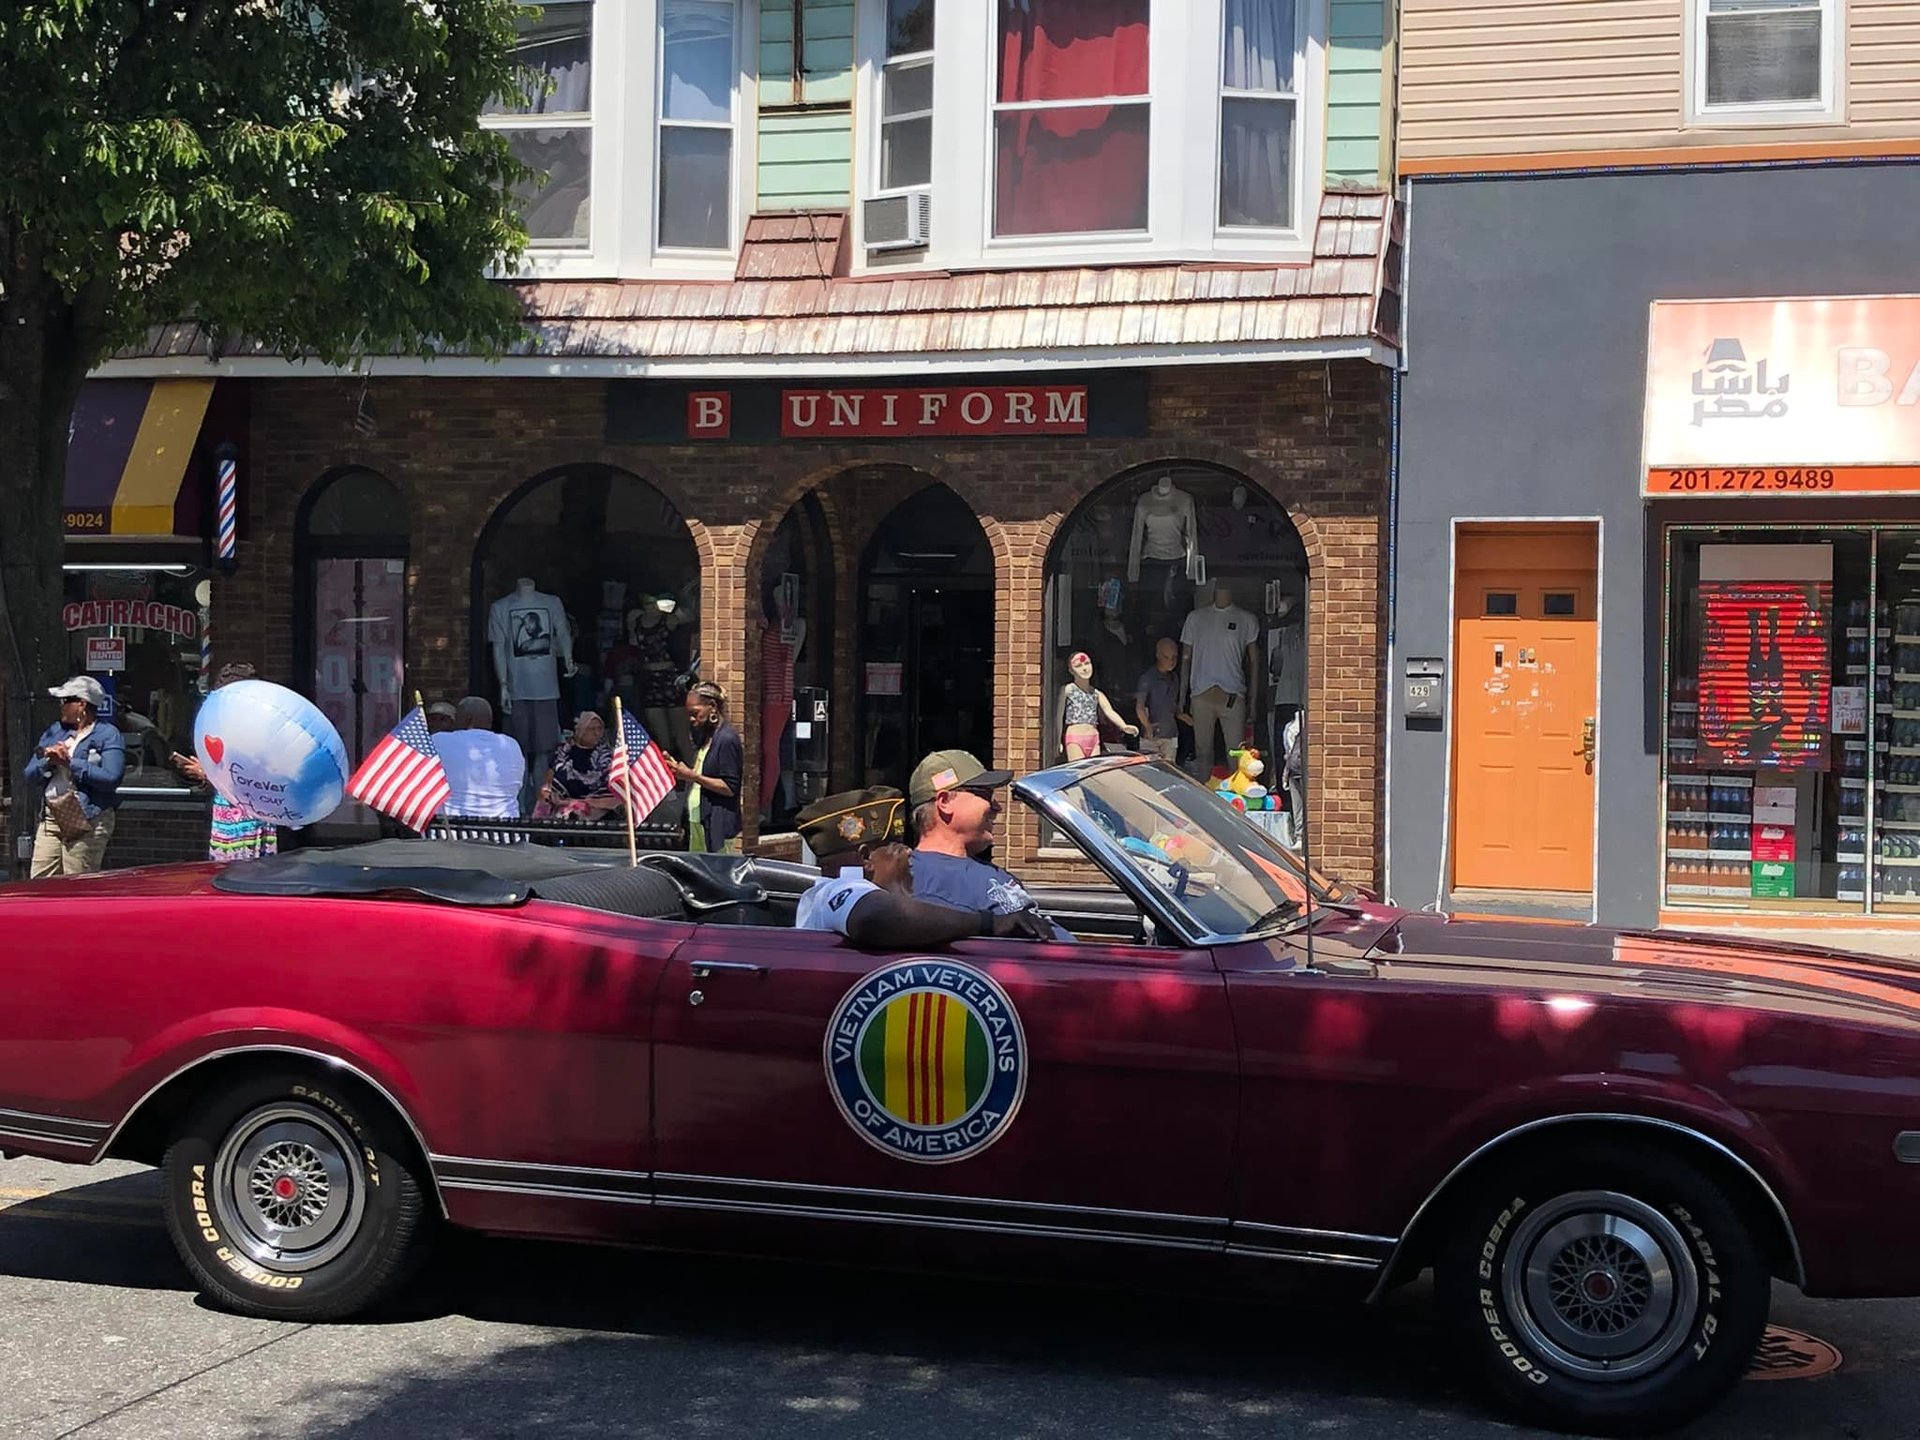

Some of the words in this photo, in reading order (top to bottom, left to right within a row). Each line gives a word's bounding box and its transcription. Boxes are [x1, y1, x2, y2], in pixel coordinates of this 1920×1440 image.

[694, 397, 725, 428] B
[788, 391, 1088, 427] UNIFORM
[1668, 469, 1835, 490] 201.272.9489
[63, 600, 196, 639] CATRACHO
[90, 651, 122, 660] WANTED
[95, 641, 117, 650] HELP
[1410, 686, 1429, 696] 429
[259, 795, 285, 807] our
[834, 969, 915, 1064] VIETNAM
[921, 966, 1016, 1073] VETERANS
[854, 1099, 887, 1128] OF
[882, 1109, 1001, 1153] AMERICA
[191, 1164, 220, 1243] COBRA
[1478, 1196, 1527, 1281] COBRA
[1671, 1202, 1722, 1304] RADIAL
[215, 1246, 304, 1290] COOPER
[1478, 1287, 1550, 1386] COOPER
